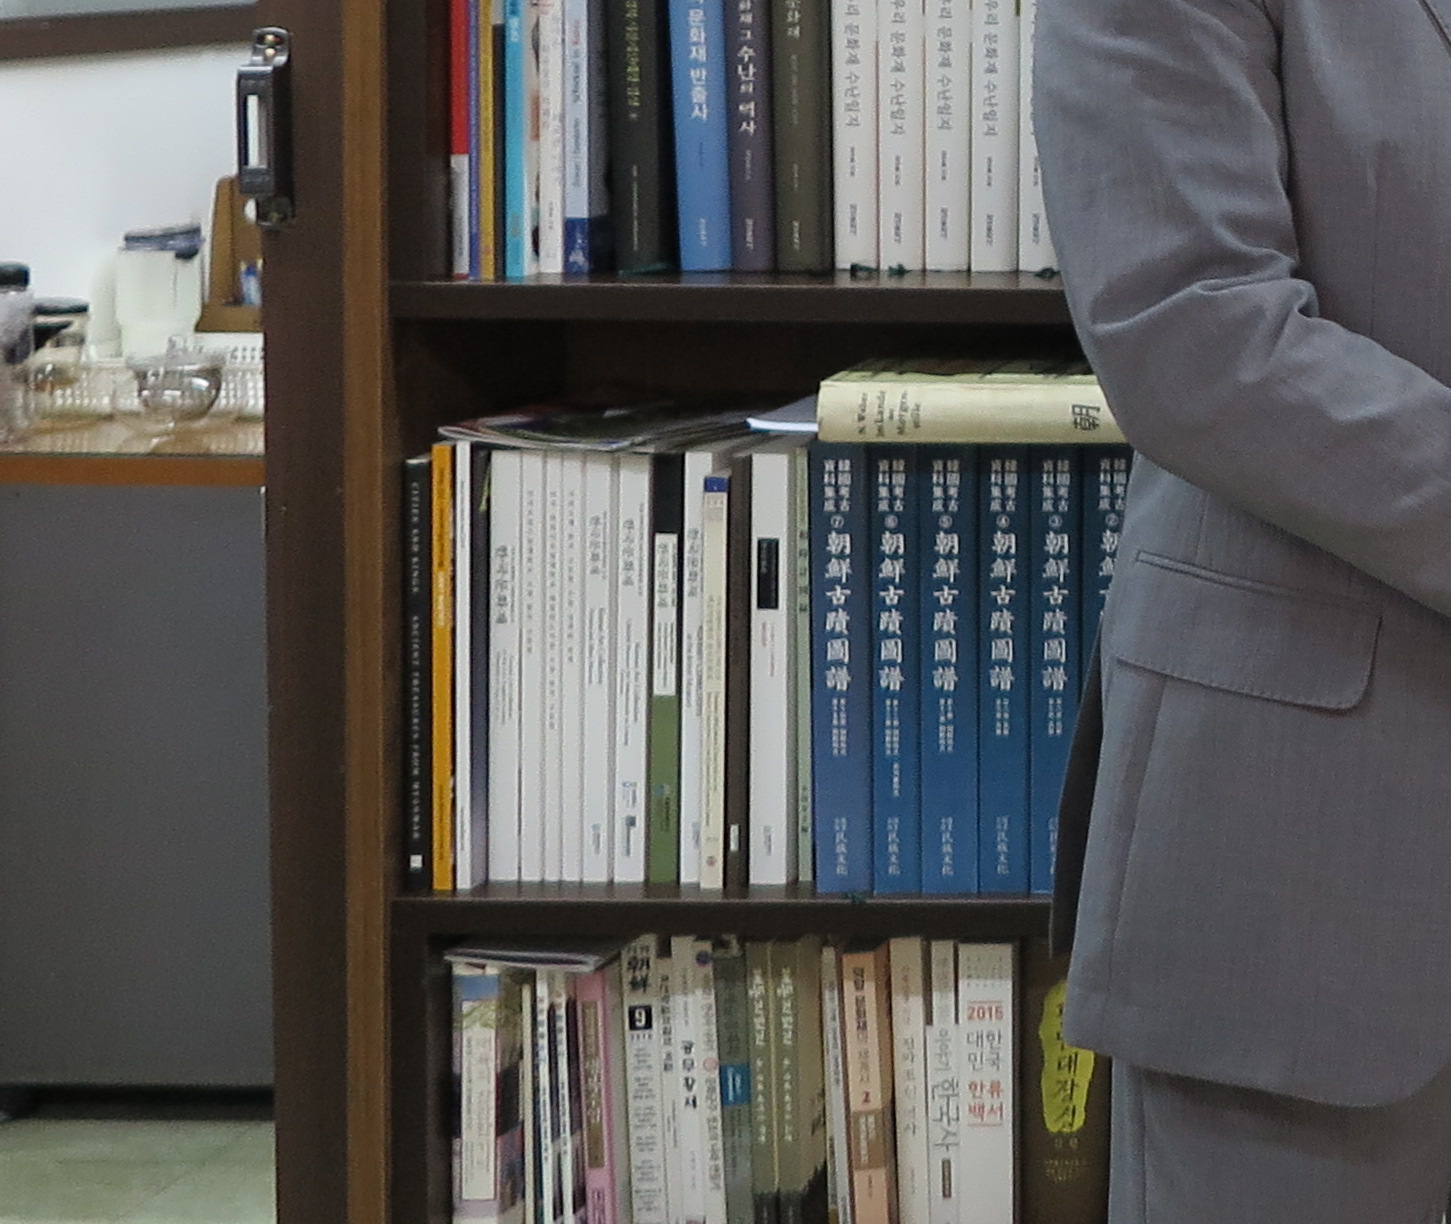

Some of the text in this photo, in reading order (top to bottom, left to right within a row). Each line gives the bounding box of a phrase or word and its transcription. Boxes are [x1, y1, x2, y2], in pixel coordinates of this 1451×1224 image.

[688, 8, 707, 61] 문화재
[844, 24, 860, 67] 문화재
[890, 31, 906, 74] 문화재
[937, 26, 953, 69] 문화재
[983, 32, 999, 76] 문화재
[737, 45, 756, 95] 수난의
[690, 69, 708, 121] 반출사
[738, 101, 756, 136] 역사
[634, 1008, 647, 1027] 9
[931, 1076, 960, 1152] 한국사
[968, 1101, 1004, 1123] 백서
